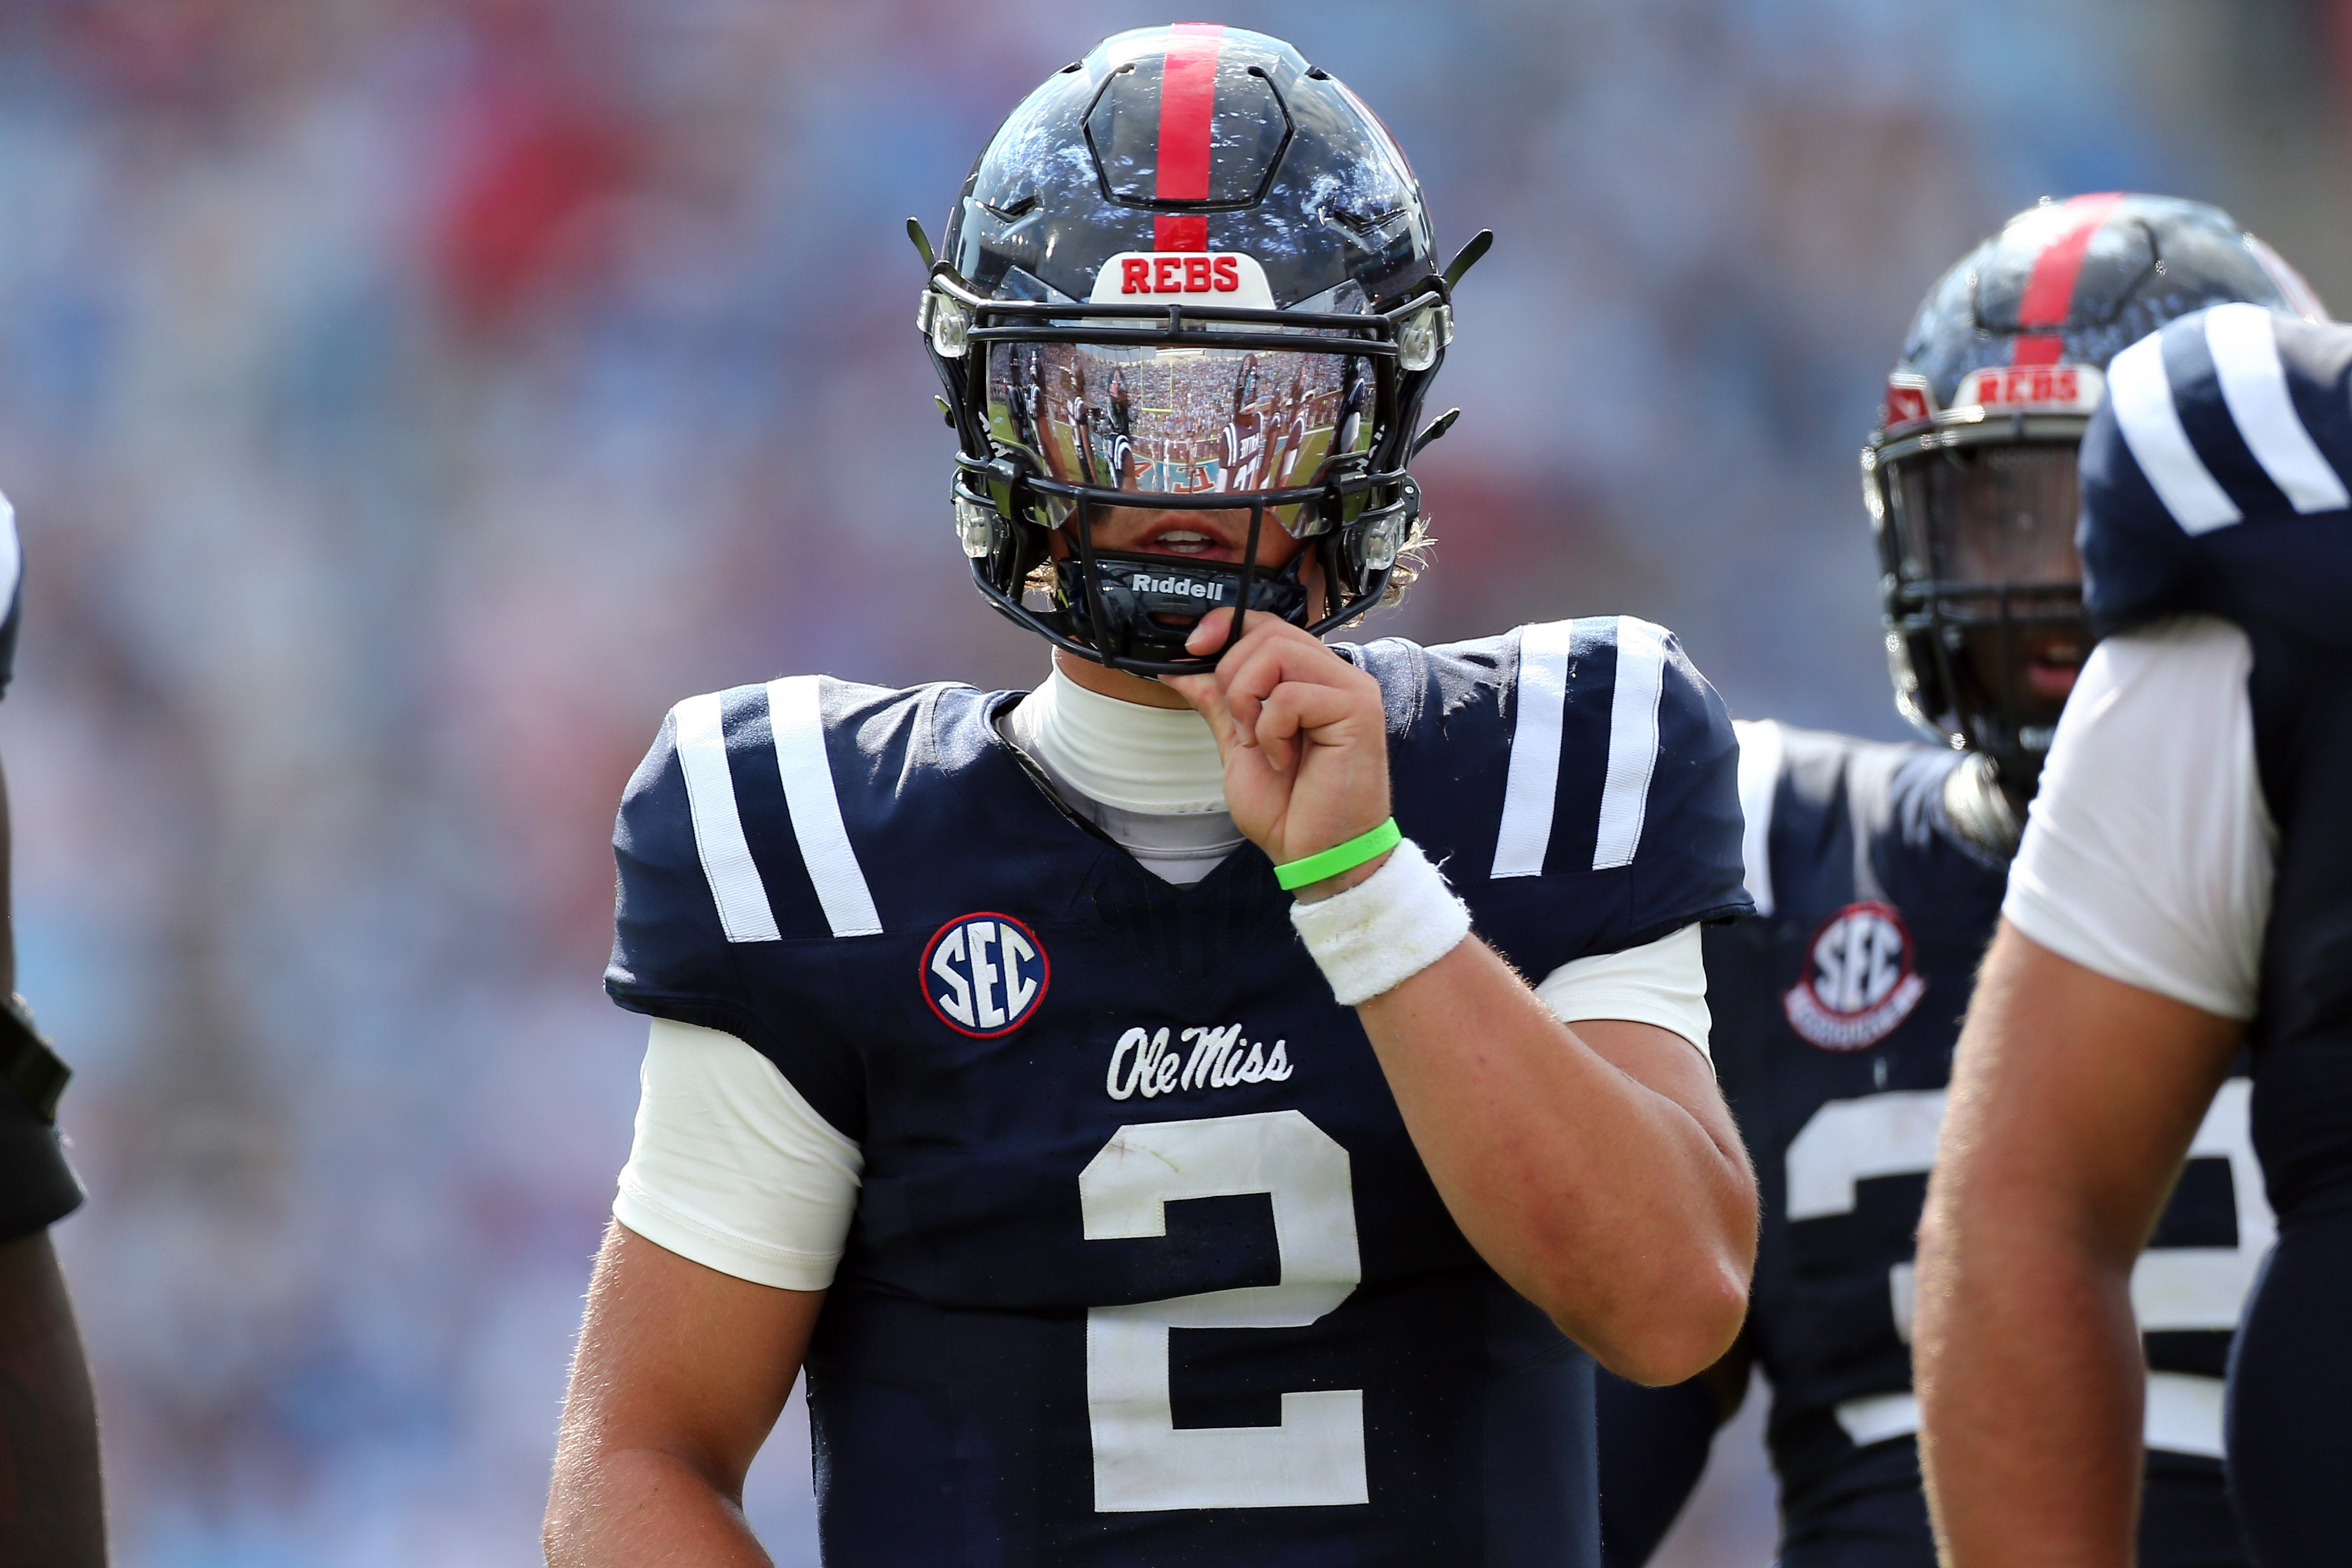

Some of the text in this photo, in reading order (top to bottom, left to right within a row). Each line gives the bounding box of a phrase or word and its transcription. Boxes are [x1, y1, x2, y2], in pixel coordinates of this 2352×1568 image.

[1120, 256, 1239, 294] REBS
[1132, 574, 1224, 601] Riddell
[931, 921, 1038, 1028] SEC
[1812, 914, 1903, 1013] SEC
[1107, 1023, 1294, 1100] Ole Miss
[1078, 1109, 1370, 1513] 2
